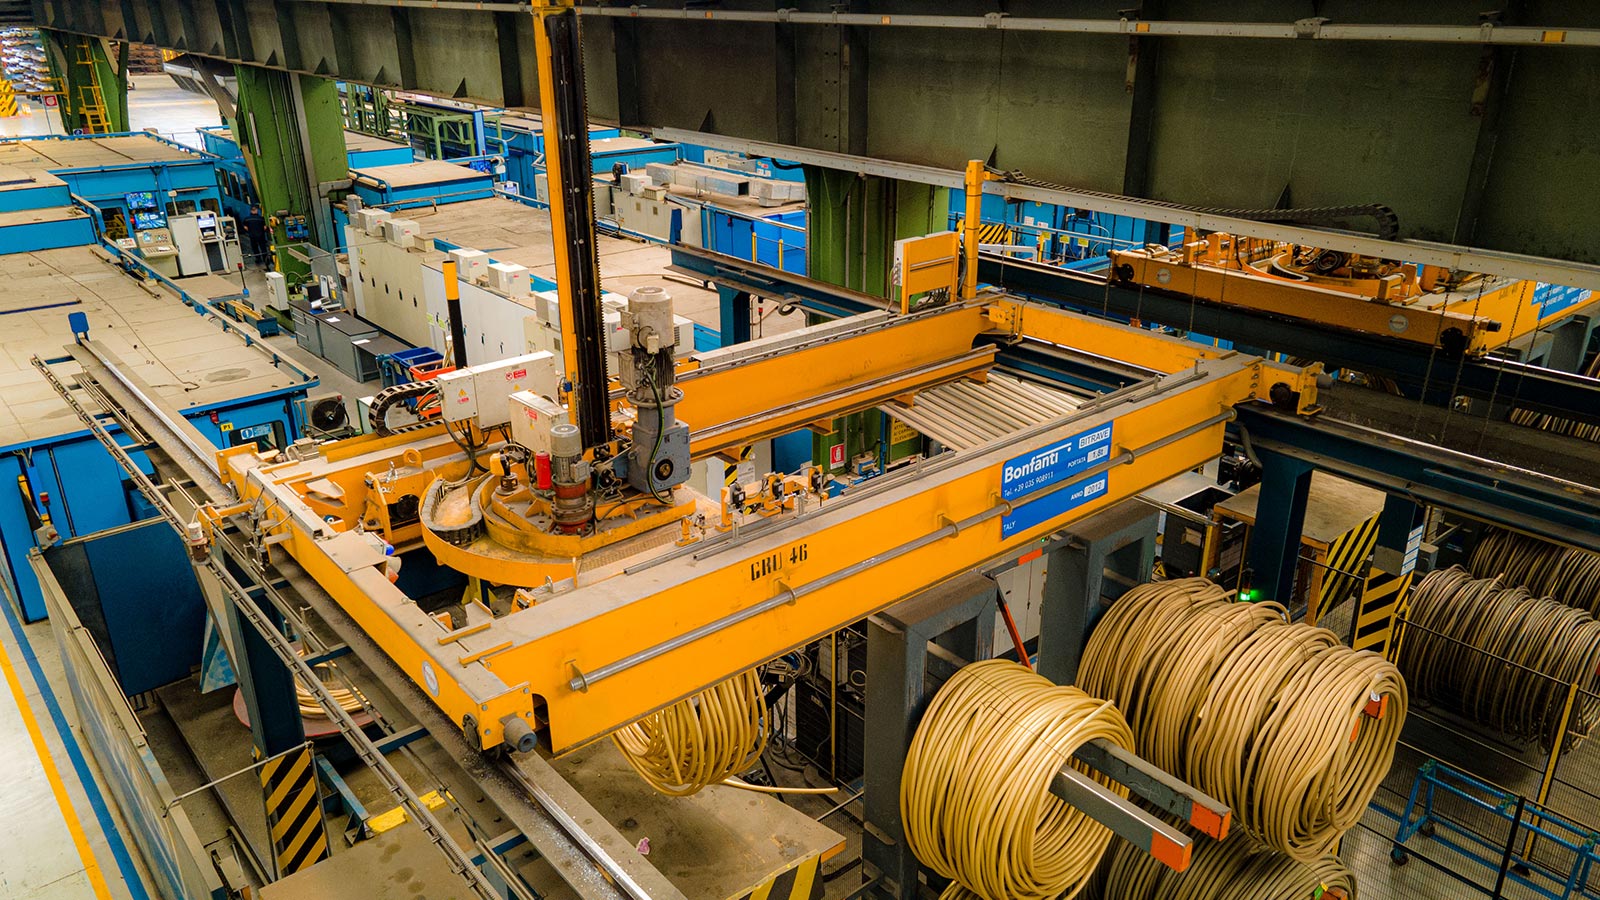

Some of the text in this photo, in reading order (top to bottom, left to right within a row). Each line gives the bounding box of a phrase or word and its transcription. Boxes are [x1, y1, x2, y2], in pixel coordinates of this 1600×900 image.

[1080, 429, 1109, 448] BITRAVE
[1004, 451, 1059, 484] Bonfanti
[1067, 456, 1086, 468] PORTATA
[1070, 482, 1102, 501] ANNO 2012
[789, 543, 808, 564] 46
